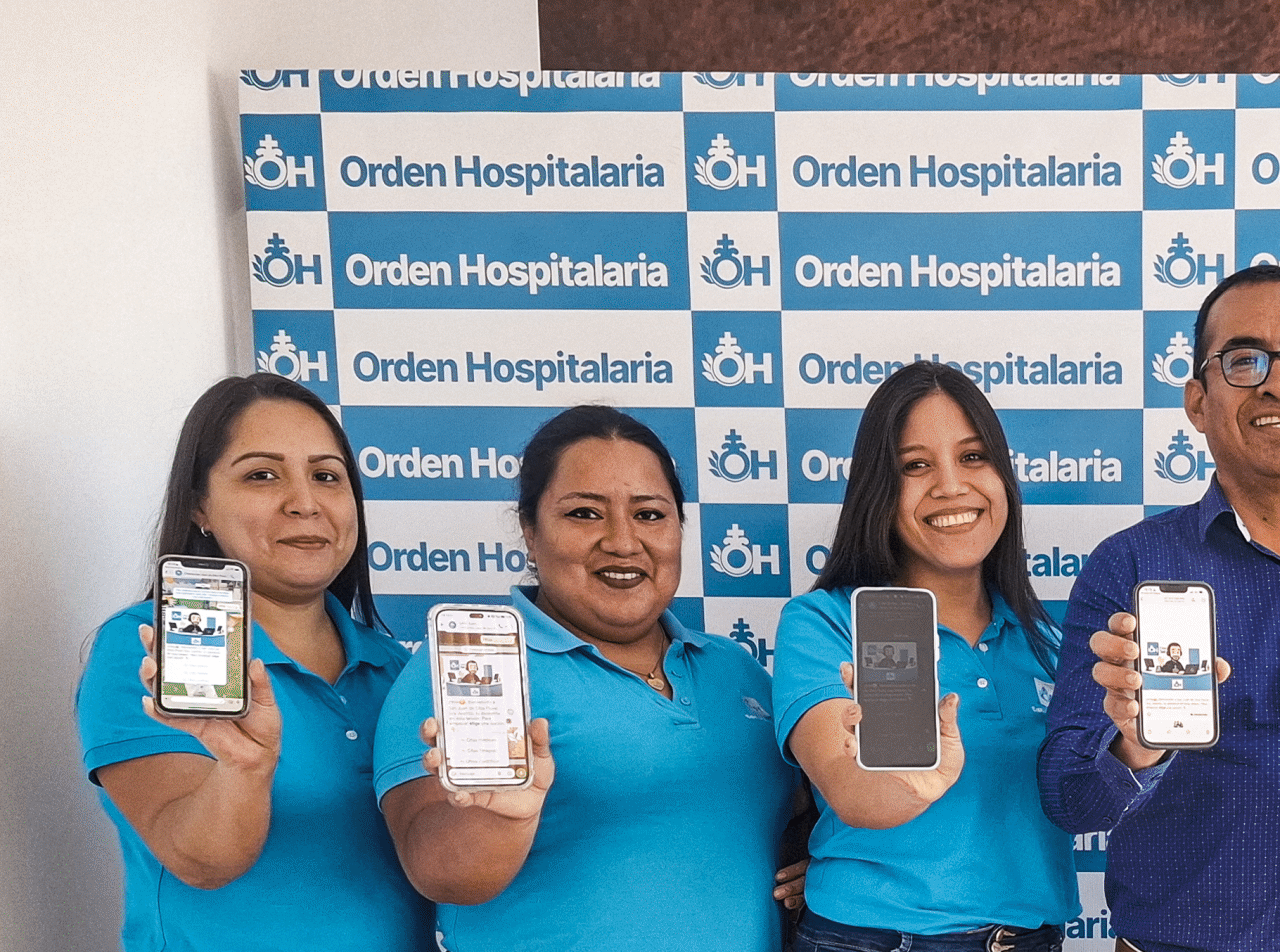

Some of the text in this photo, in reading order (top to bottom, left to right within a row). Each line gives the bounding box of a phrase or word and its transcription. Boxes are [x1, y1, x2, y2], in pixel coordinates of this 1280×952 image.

[340, 154, 665, 195] Orden Hospitalaria
[793, 152, 1122, 196] Orden Hospitalaria
[345, 252, 669, 294] Orden Hospitalaria
[795, 252, 1121, 295] Orden Hospitalaria
[353, 350, 673, 391] Orden Hospitalaria
[914, 350, 1122, 393] spitalaria
[358, 446, 464, 479] Orden
[1011, 449, 1121, 482] italaria
[368, 541, 470, 572] Orden
